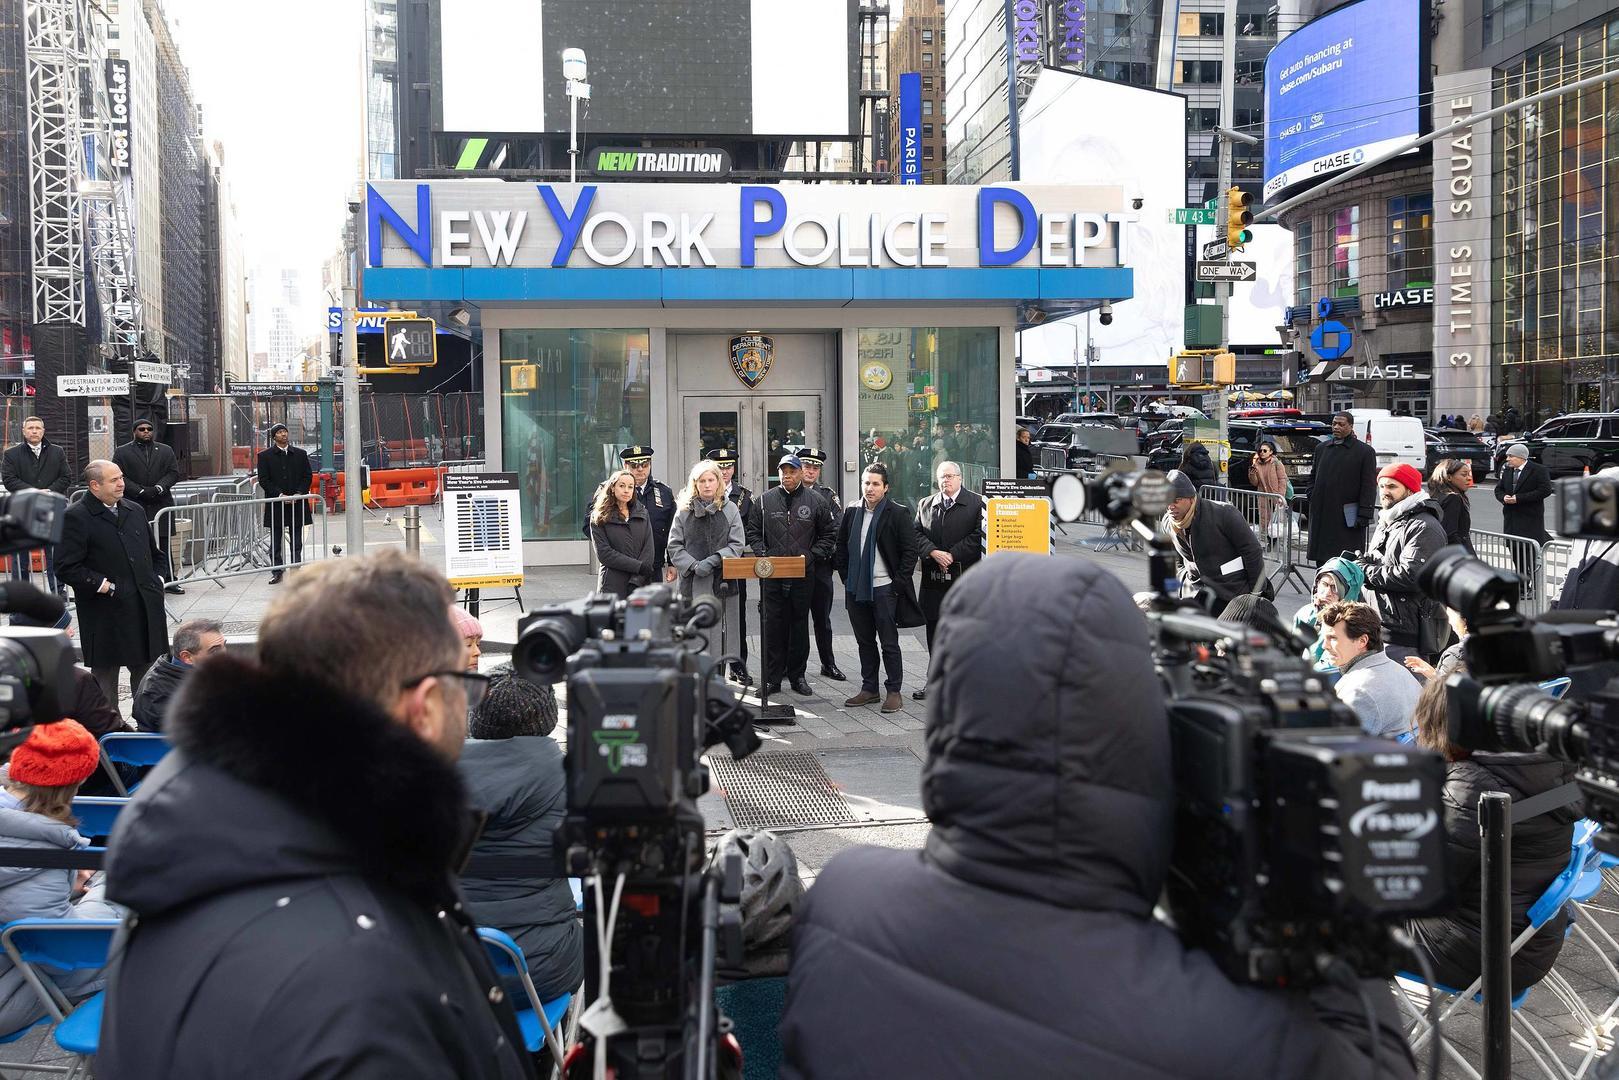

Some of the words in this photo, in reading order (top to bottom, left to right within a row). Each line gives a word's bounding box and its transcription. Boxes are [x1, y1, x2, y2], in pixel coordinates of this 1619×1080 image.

[1280, 68, 1289, 80] Get
[1290, 61, 1304, 74] auto
[1304, 42, 1342, 66] financing
[1343, 38, 1353, 50] at
[1280, 58, 1342, 96] chase.com/Subaru
[1280, 127, 1296, 140] CHASE
[905, 127, 916, 174] PARIS
[1313, 152, 1350, 173] CHASE
[366, 182, 528, 268] NEW
[536, 184, 716, 268] YORK
[740, 184, 950, 268] POLICE
[978, 186, 1138, 268] DEPT
[1178, 211, 1188, 222] W
[1192, 211, 1204, 223] 43
[1374, 288, 1434, 308] CHASE
[1450, 245, 1472, 336] TIMES
[732, 342, 770, 351] DEPARTMENT
[732, 356, 740, 370] CITY
[1450, 352, 1472, 366] 3
[1338, 364, 1414, 380] CHASE
